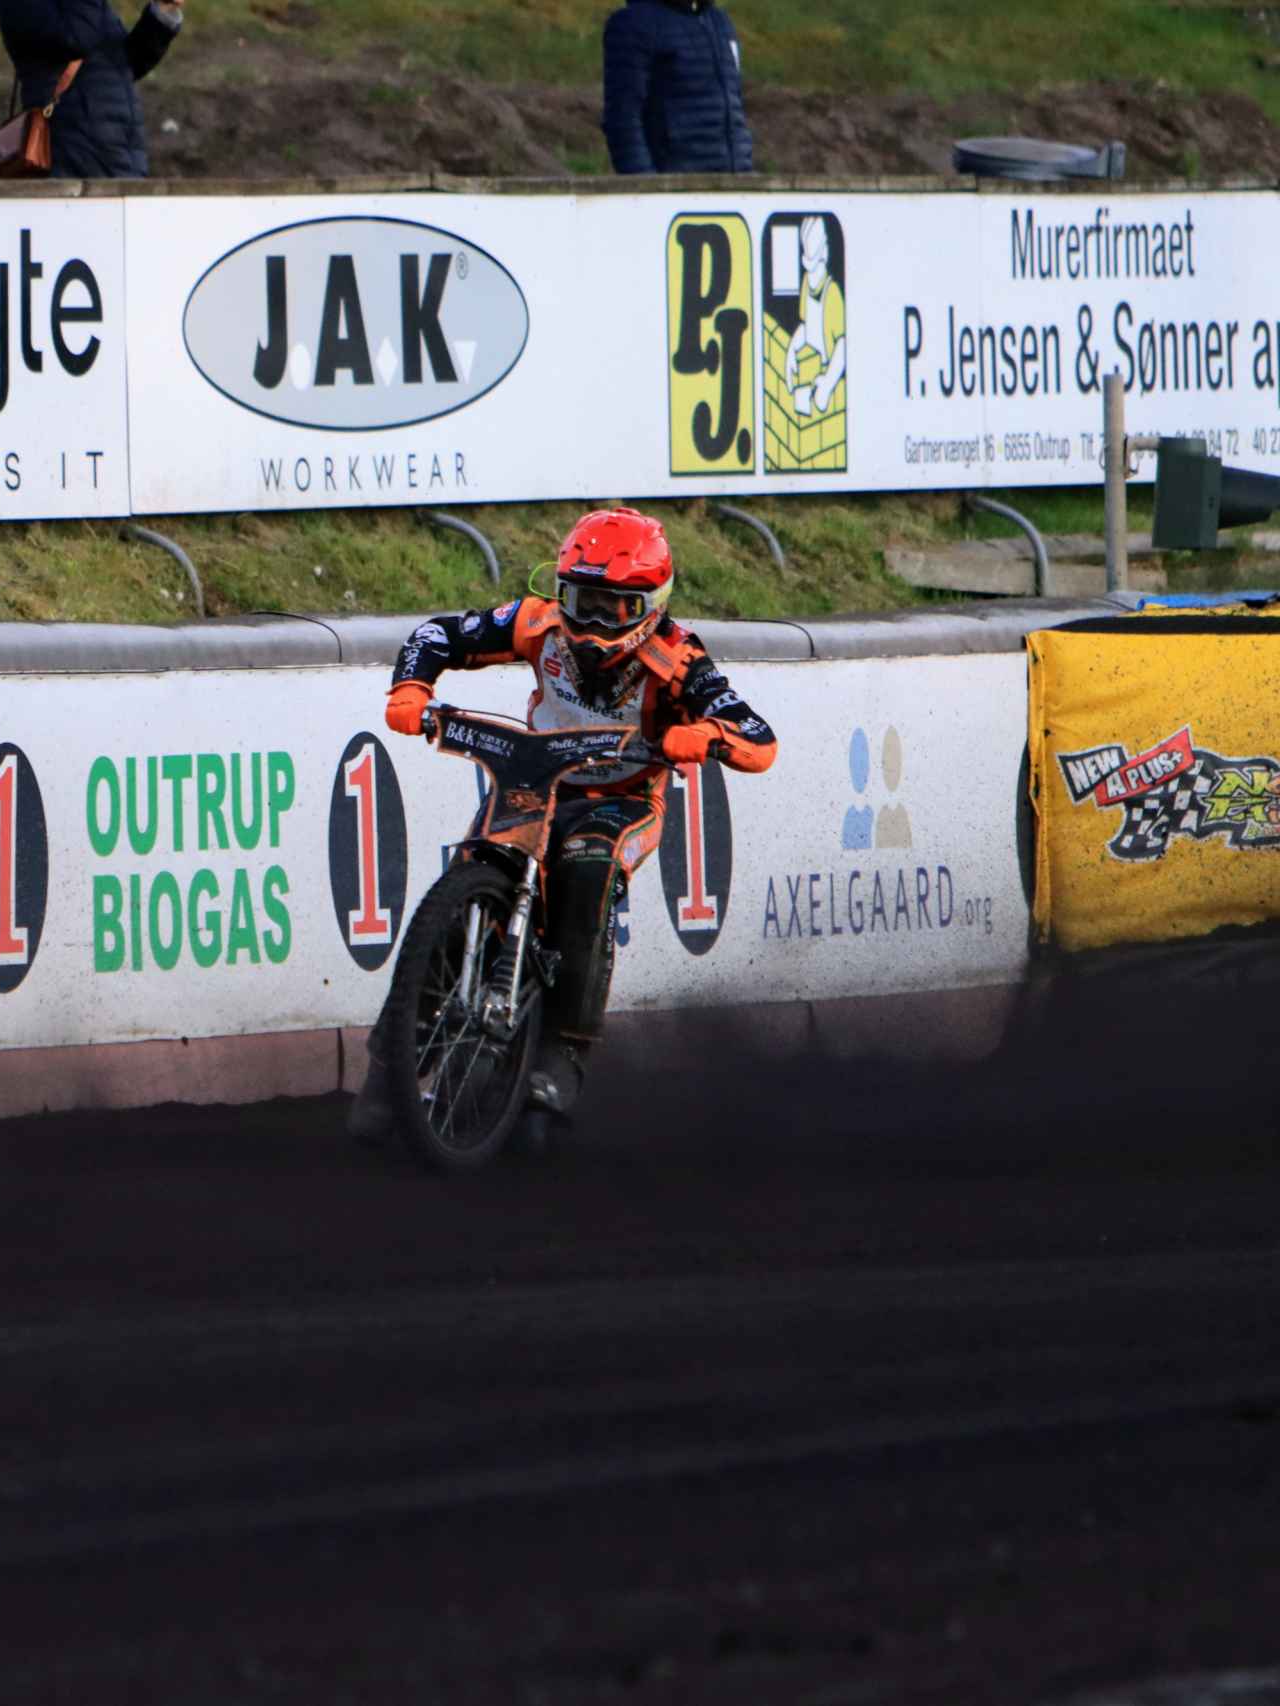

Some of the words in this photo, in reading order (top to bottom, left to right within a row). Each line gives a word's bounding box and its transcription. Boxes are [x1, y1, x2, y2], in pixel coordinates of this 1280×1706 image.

[1011, 208, 1195, 280] Murerfirmaet
[904, 306, 926, 398] P.
[940, 305, 1061, 398] Jensen
[1075, 303, 1101, 394] &
[1113, 300, 1239, 398] Sønner
[61, 451, 105, 489] IT
[260, 451, 468, 493] WORKWEAR
[1003, 432, 1032, 462] 6855
[1034, 432, 1070, 465] Outrup
[85, 751, 296, 857] OUTRUP
[1065, 747, 1121, 795] NEW
[91, 864, 293, 973] BIOGAS
[762, 865, 955, 939] AXELGAARD
